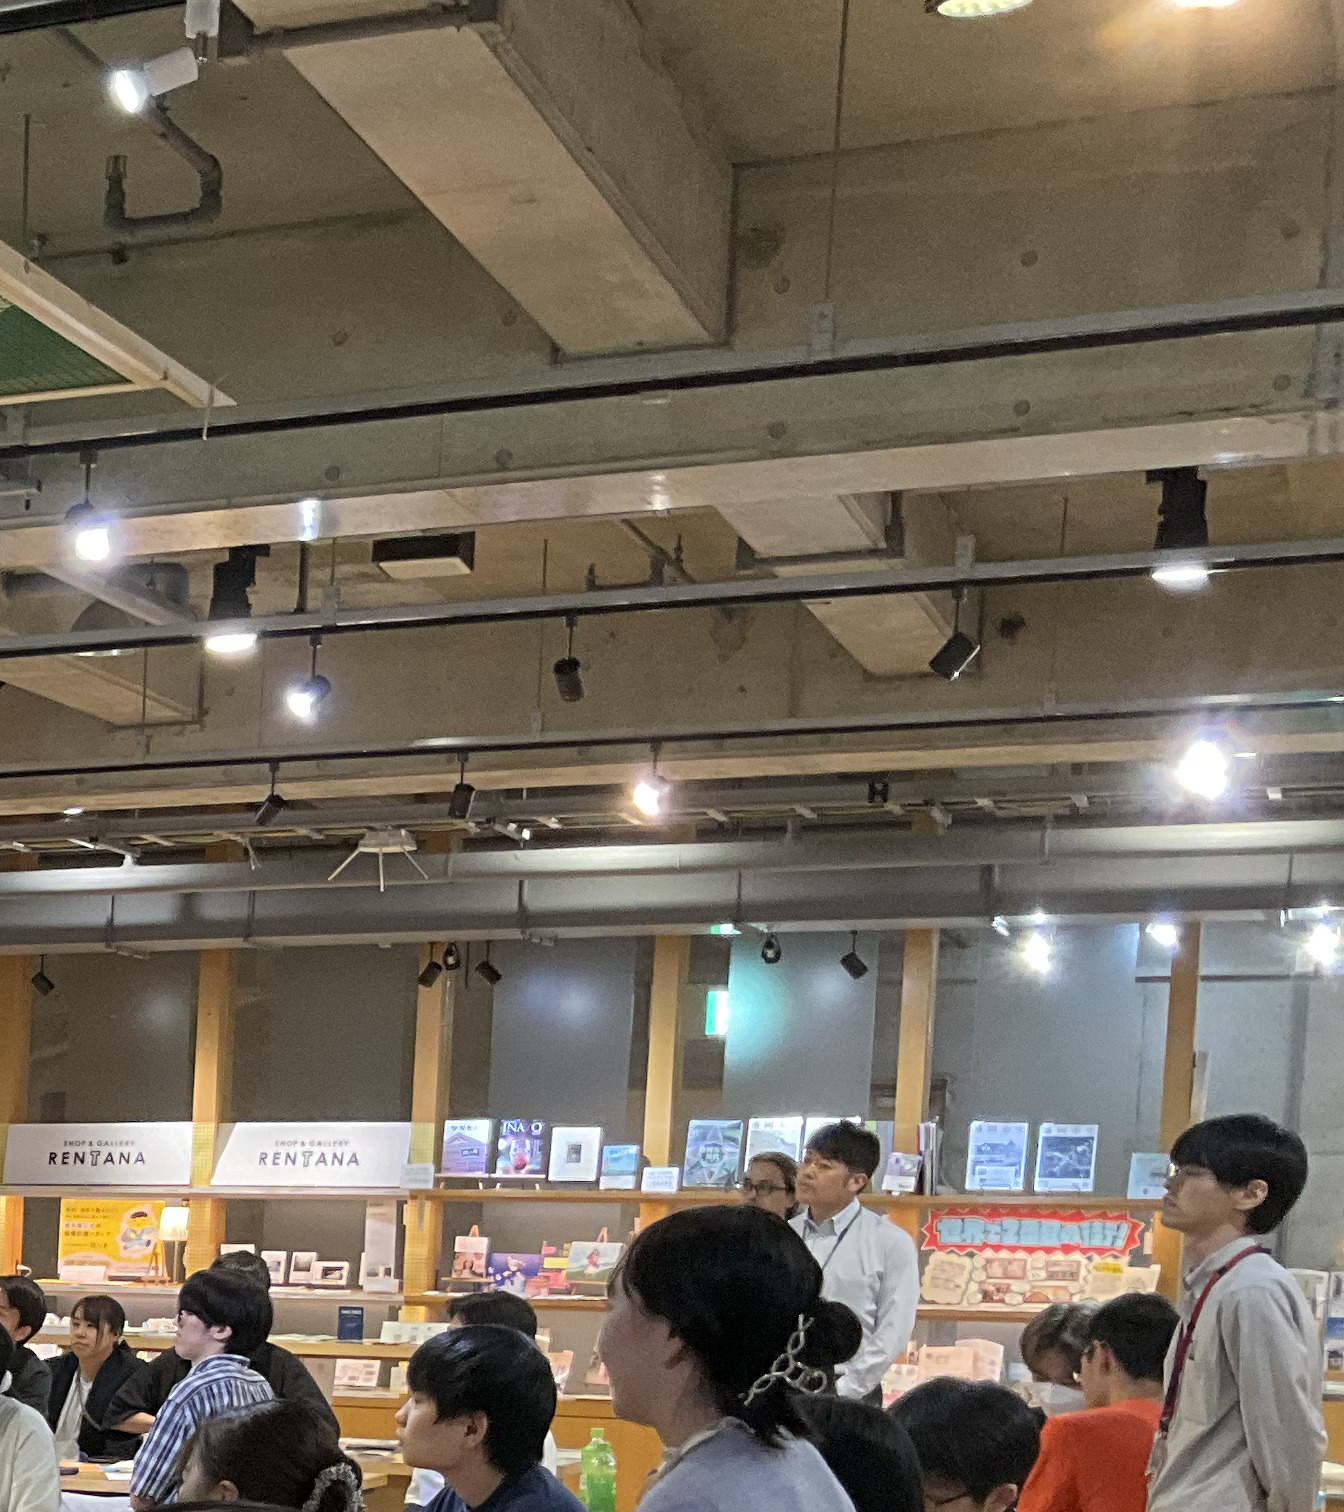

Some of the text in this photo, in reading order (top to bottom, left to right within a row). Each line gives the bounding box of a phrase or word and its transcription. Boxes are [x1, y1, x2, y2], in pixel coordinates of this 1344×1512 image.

[96, 1139, 135, 1147] GALLERY
[274, 1139, 298, 1147] SHOP
[48, 1150, 146, 1167] RENTANA
[258, 1150, 360, 1168] RENTANA
